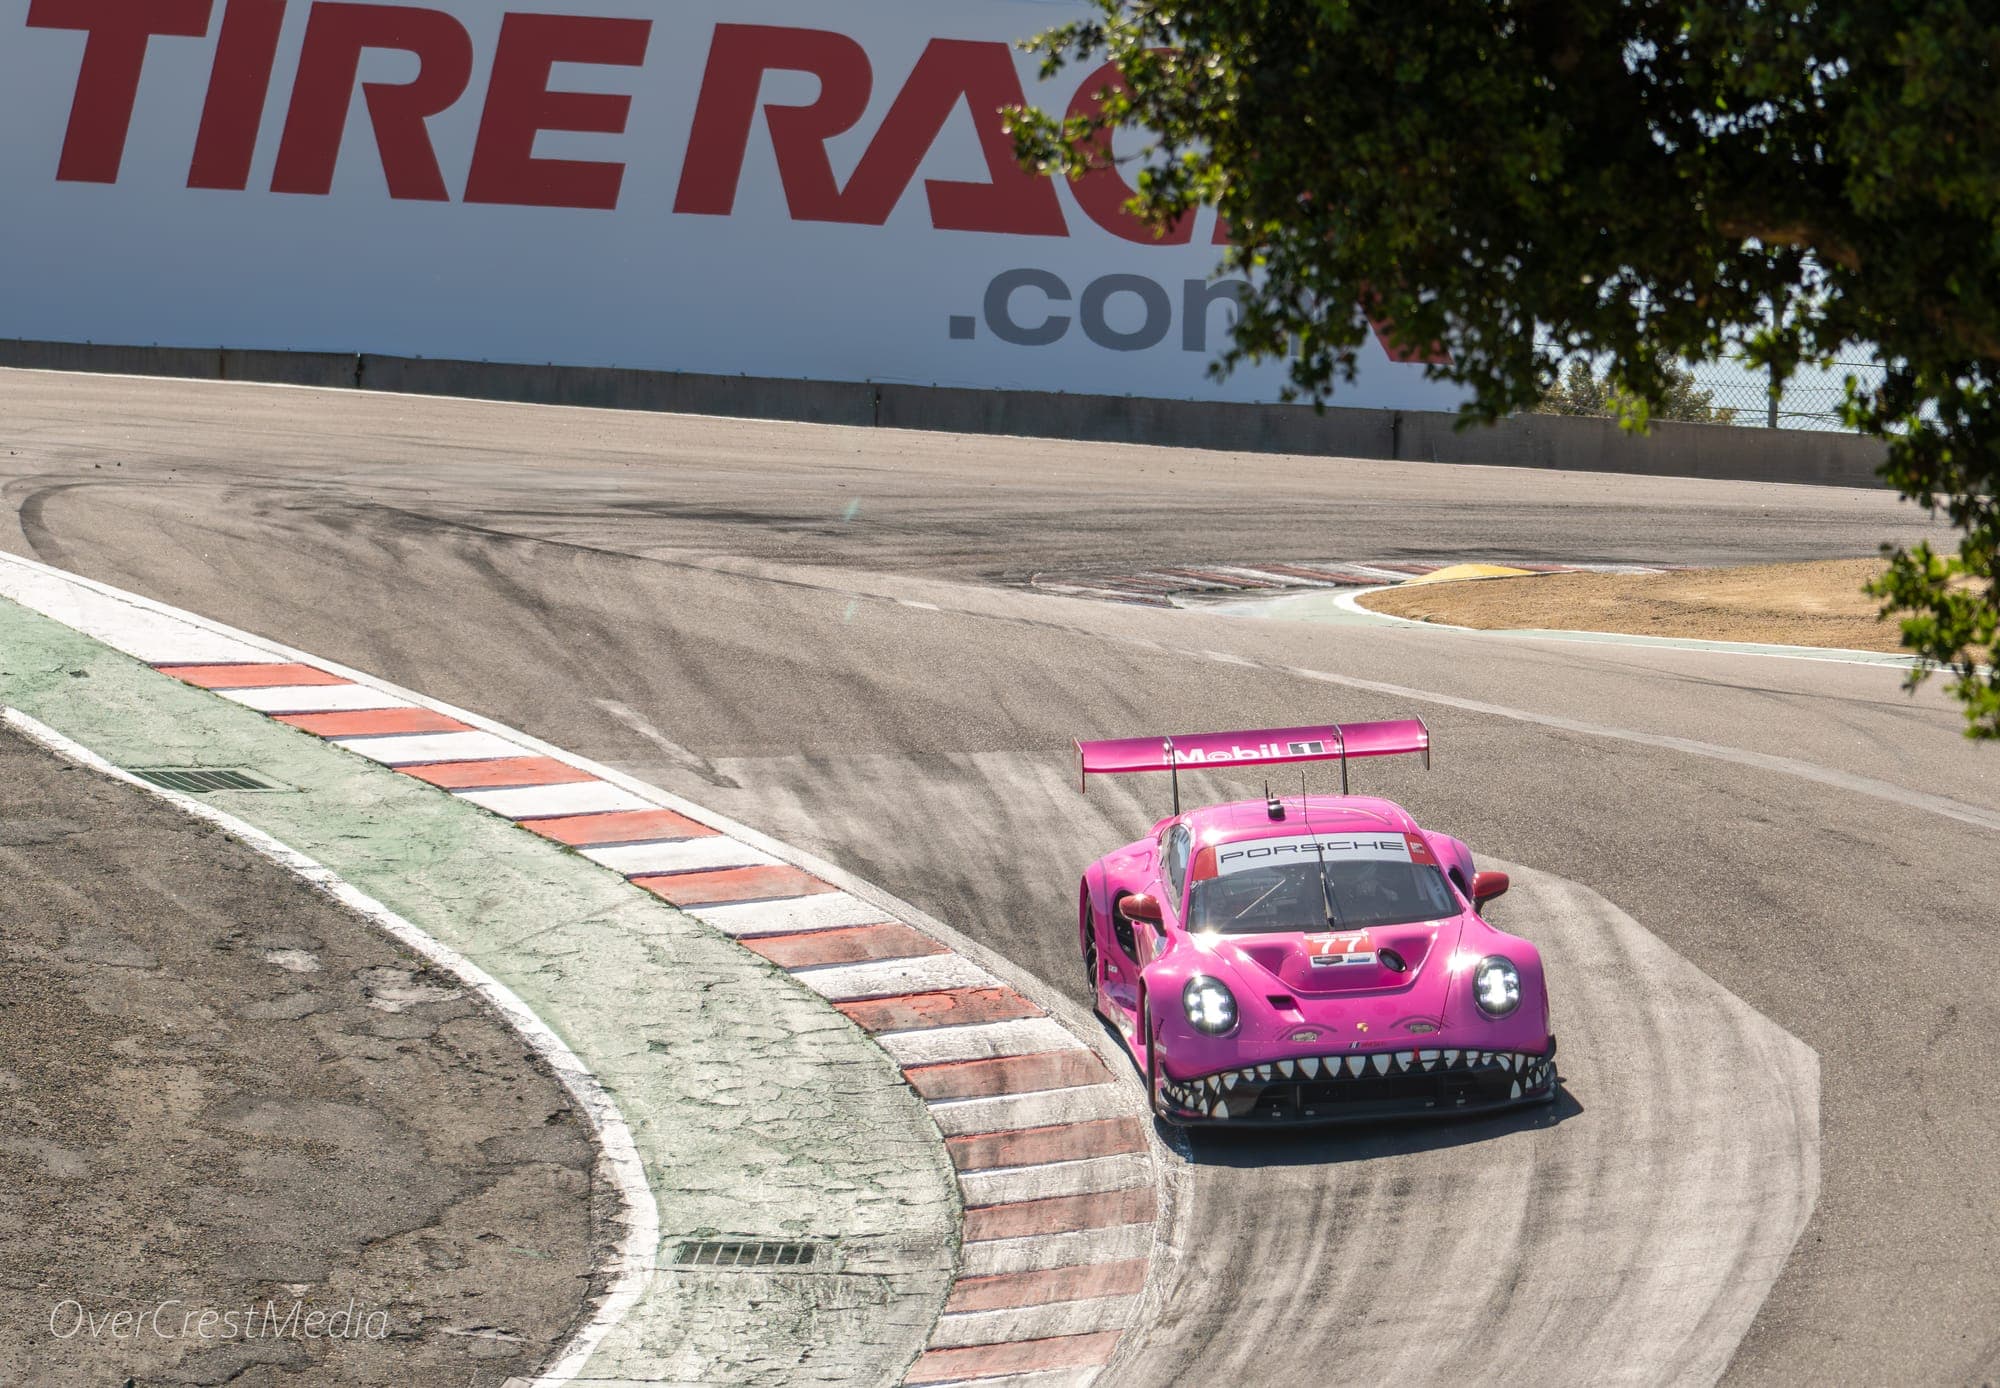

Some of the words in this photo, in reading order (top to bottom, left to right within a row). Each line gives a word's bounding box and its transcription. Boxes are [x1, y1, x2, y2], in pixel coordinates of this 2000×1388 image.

[26, 0, 653, 210] TIRE
[1173, 743, 1281, 763] Mobil
[1221, 841, 1405, 864] PORSCHE
[1312, 937, 1362, 954] 77
